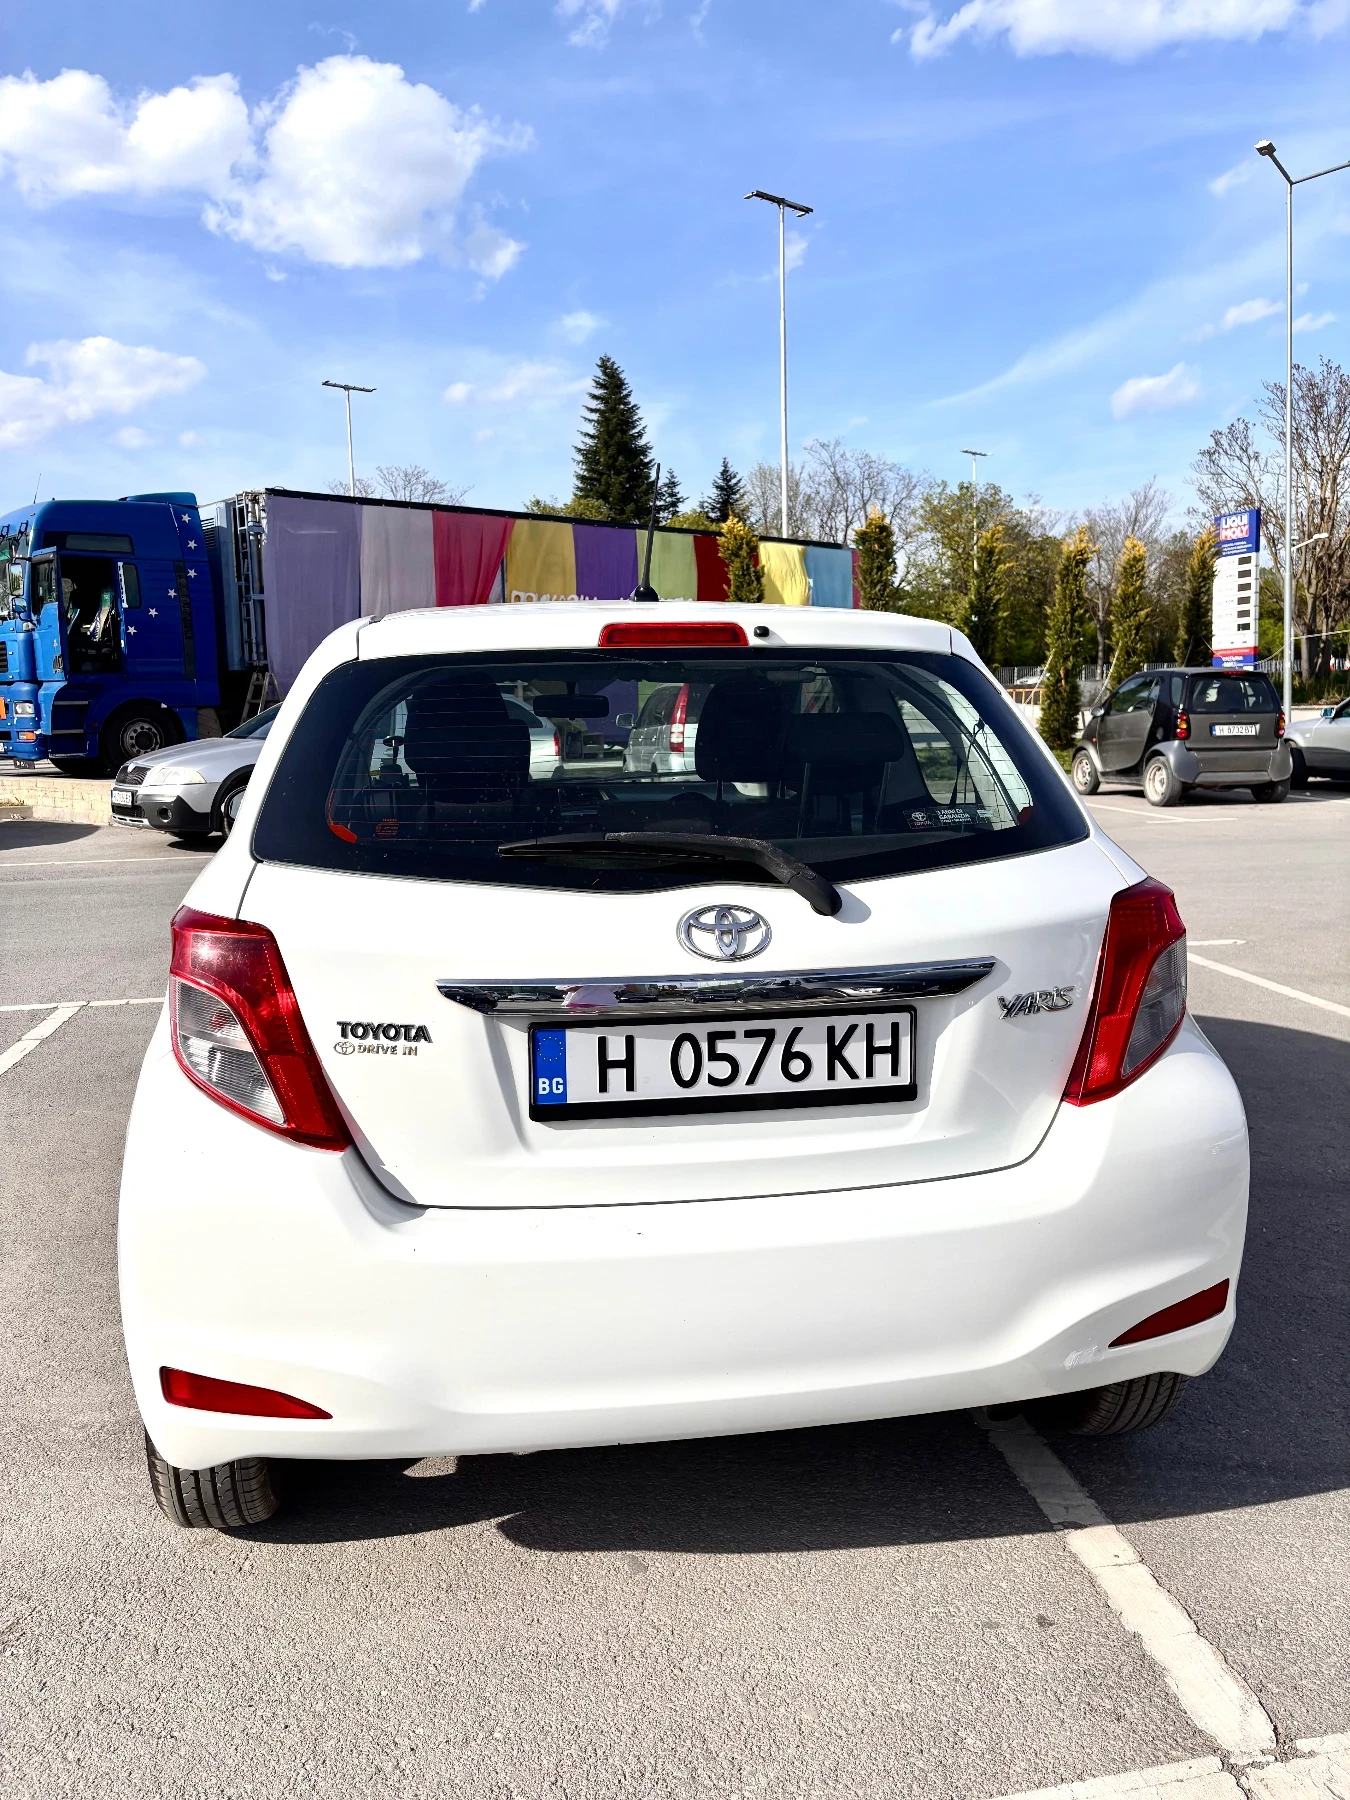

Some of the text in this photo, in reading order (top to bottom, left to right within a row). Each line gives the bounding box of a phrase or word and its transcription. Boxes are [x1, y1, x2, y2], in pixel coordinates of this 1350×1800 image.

[1222, 514, 1248, 528] LIQUI
[1221, 526, 1249, 540] MOLY
[336, 1021, 433, 1043] TOYOTA
[357, 1044, 418, 1056] DRIVE IN
[597, 1021, 900, 1093] H 0576 KH
[538, 1077, 564, 1095] BG
